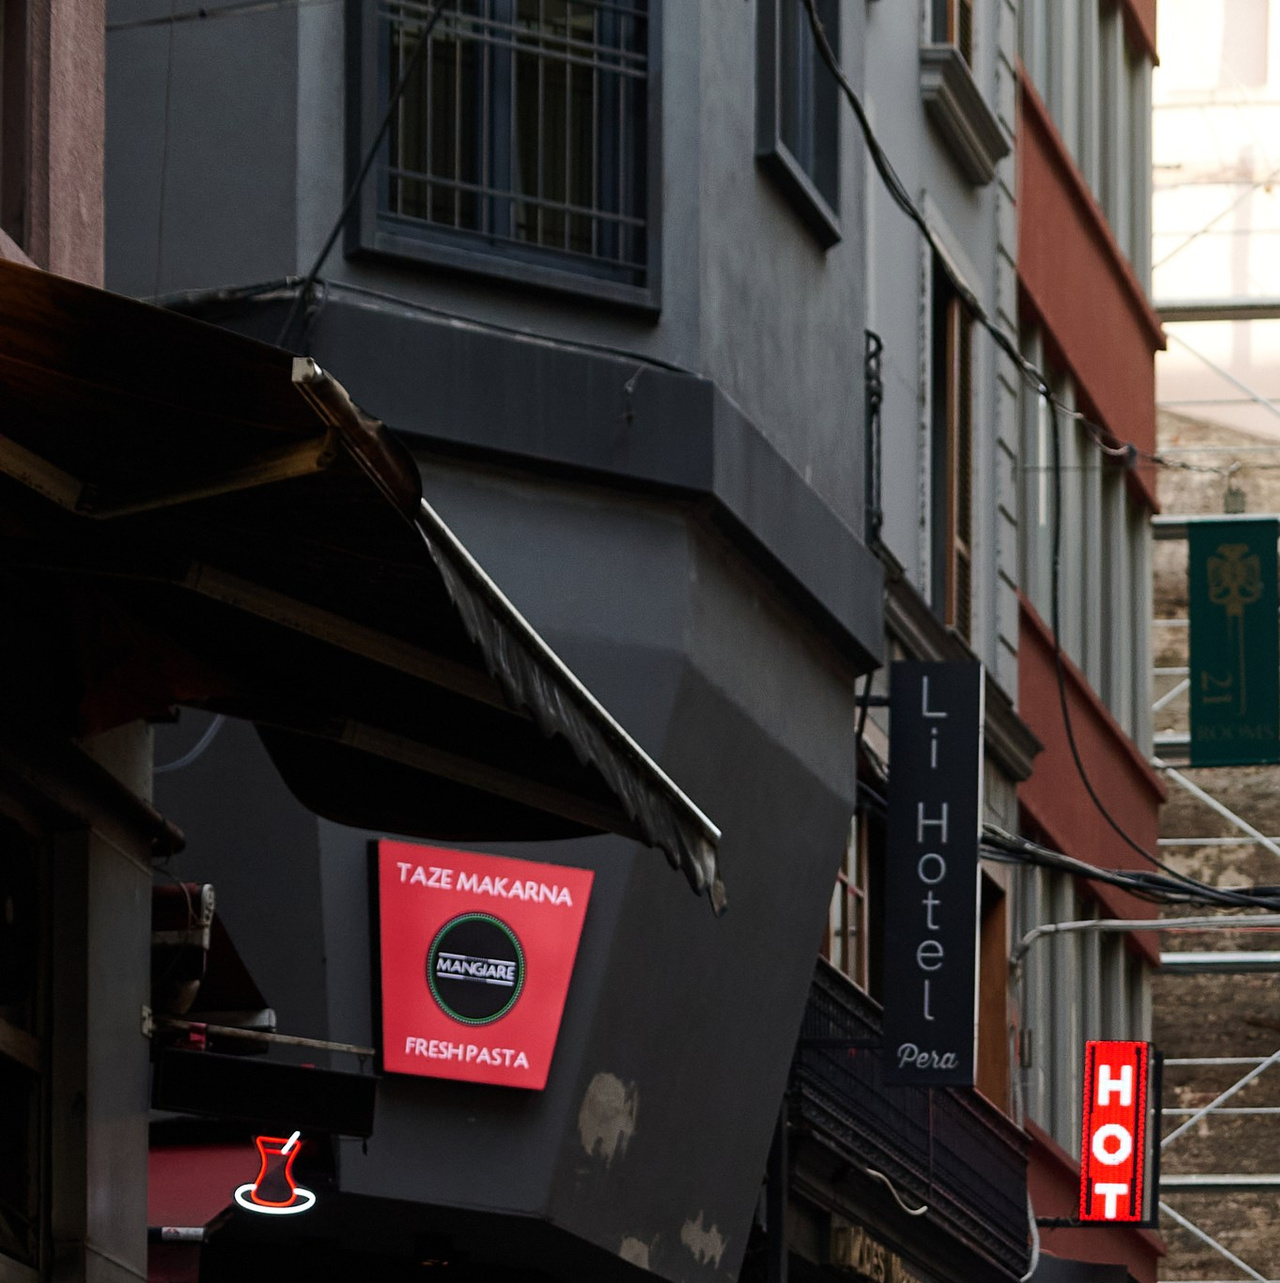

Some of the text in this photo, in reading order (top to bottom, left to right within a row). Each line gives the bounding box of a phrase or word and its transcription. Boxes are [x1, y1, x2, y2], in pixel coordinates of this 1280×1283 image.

[397, 862, 573, 907] TAZE MAKARNA
[916, 801, 949, 1021] Hotel
[436, 957, 516, 981] MANGIARE
[405, 1036, 530, 1069] FRESH PASTA
[897, 1041, 959, 1070] Pera
[1091, 1063, 1134, 1220] HOT
